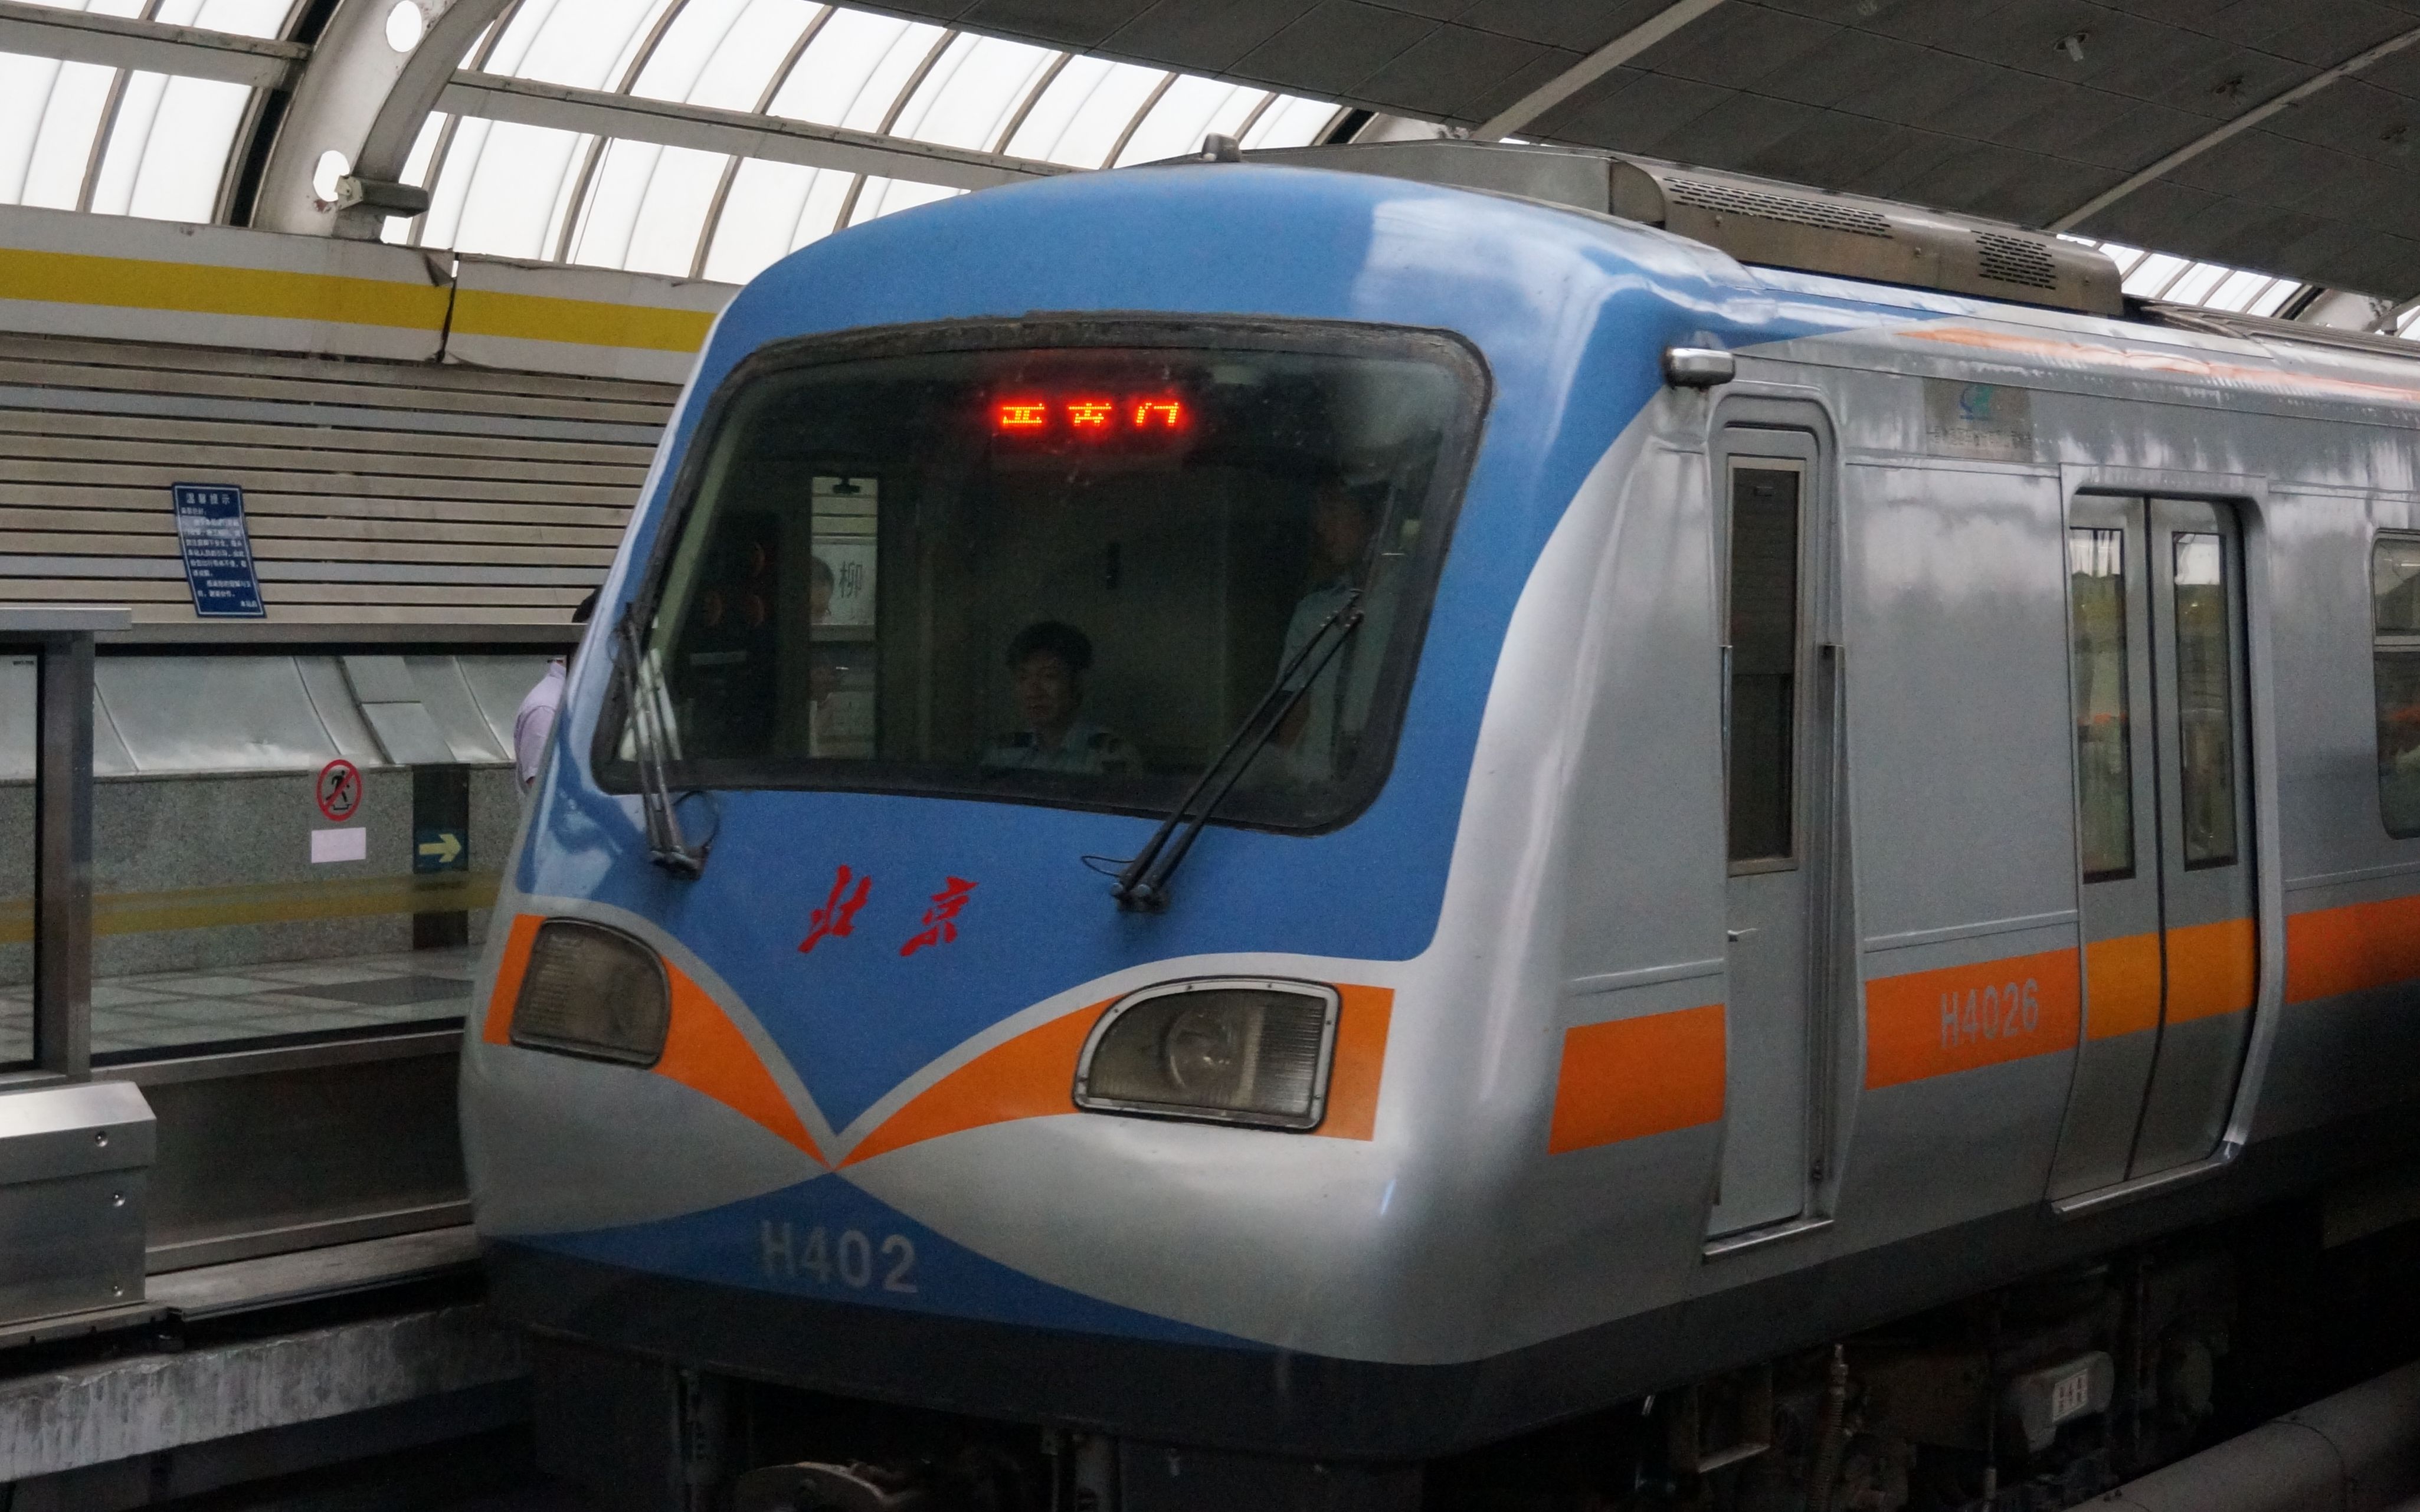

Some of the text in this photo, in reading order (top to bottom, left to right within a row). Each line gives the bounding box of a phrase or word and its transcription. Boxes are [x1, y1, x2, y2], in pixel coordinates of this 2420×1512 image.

[798, 864, 980, 957] 北京
[1940, 978, 2039, 1049] H4026
[761, 1219, 918, 1293] H402
